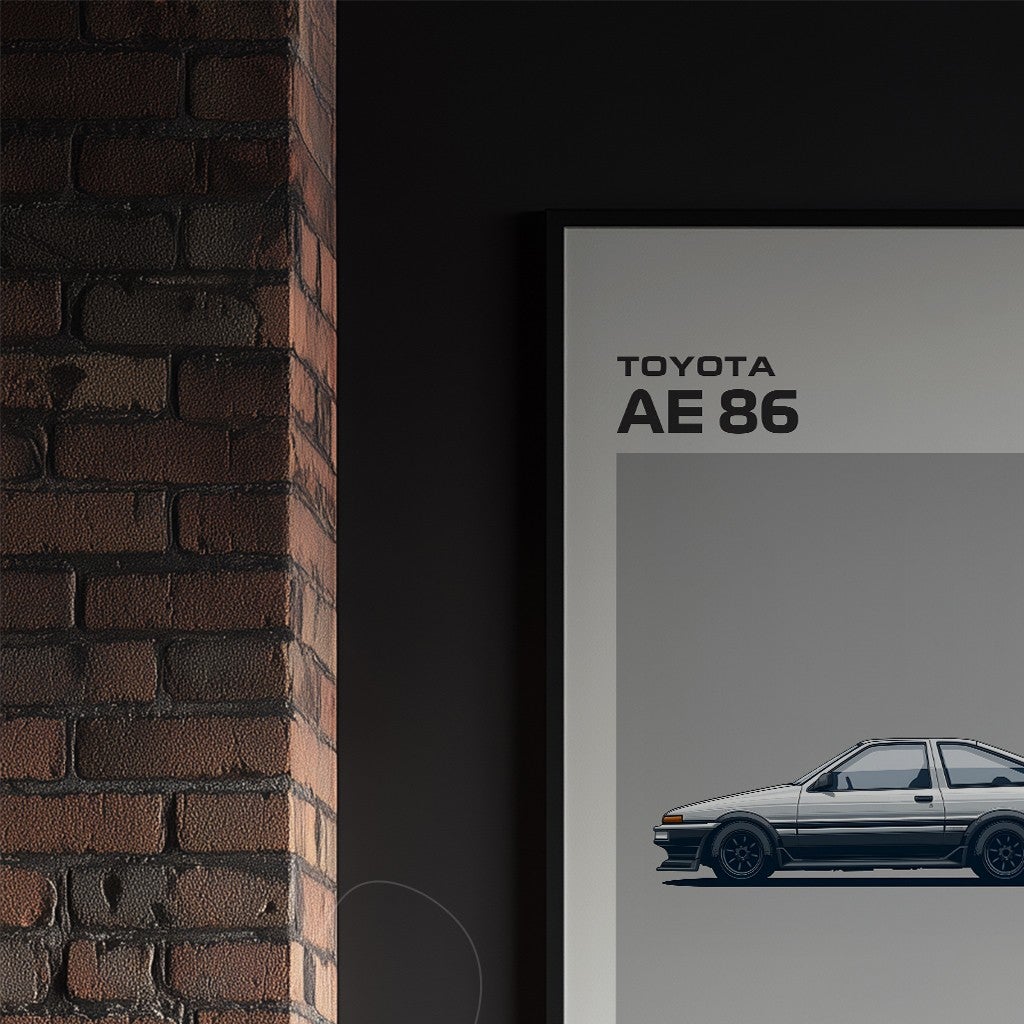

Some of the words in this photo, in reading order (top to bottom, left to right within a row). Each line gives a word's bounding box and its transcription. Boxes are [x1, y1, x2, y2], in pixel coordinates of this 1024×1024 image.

[616, 355, 776, 377] TOYOTA
[616, 388, 703, 434] AE
[719, 388, 799, 435] 86
